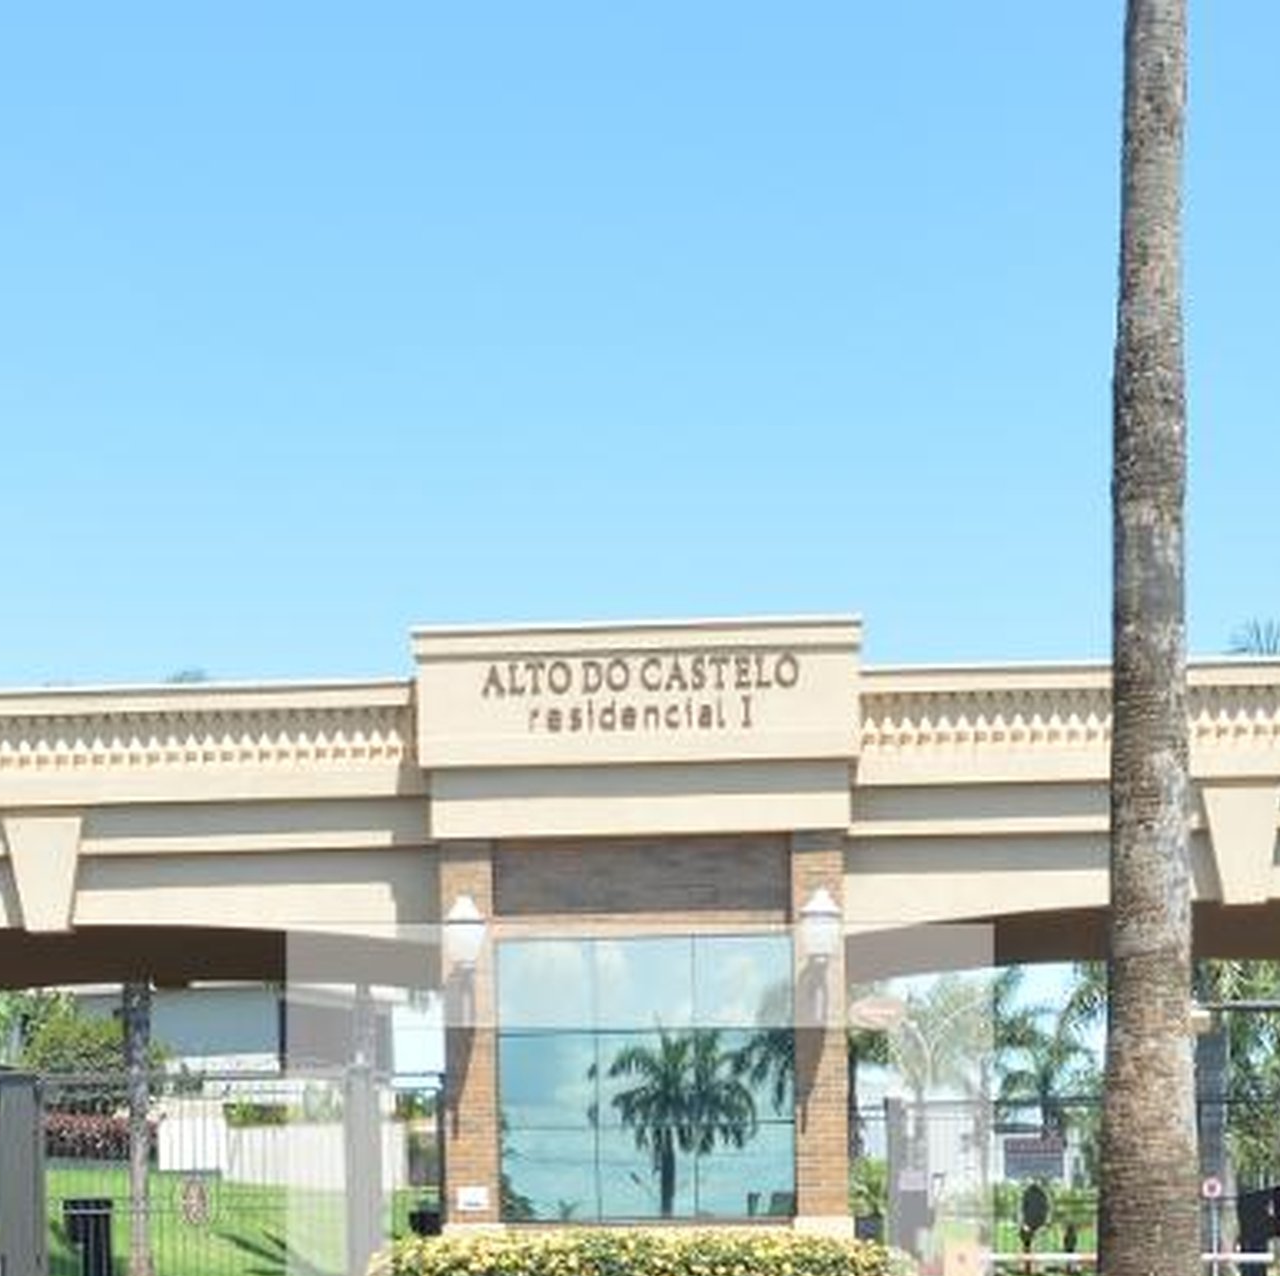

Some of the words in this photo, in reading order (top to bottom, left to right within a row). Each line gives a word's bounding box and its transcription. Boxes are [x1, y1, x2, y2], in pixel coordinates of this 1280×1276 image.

[482, 661, 573, 697] ALTO
[582, 658, 630, 694] DO
[640, 653, 800, 692] CASTELO
[529, 698, 725, 733] residencial
